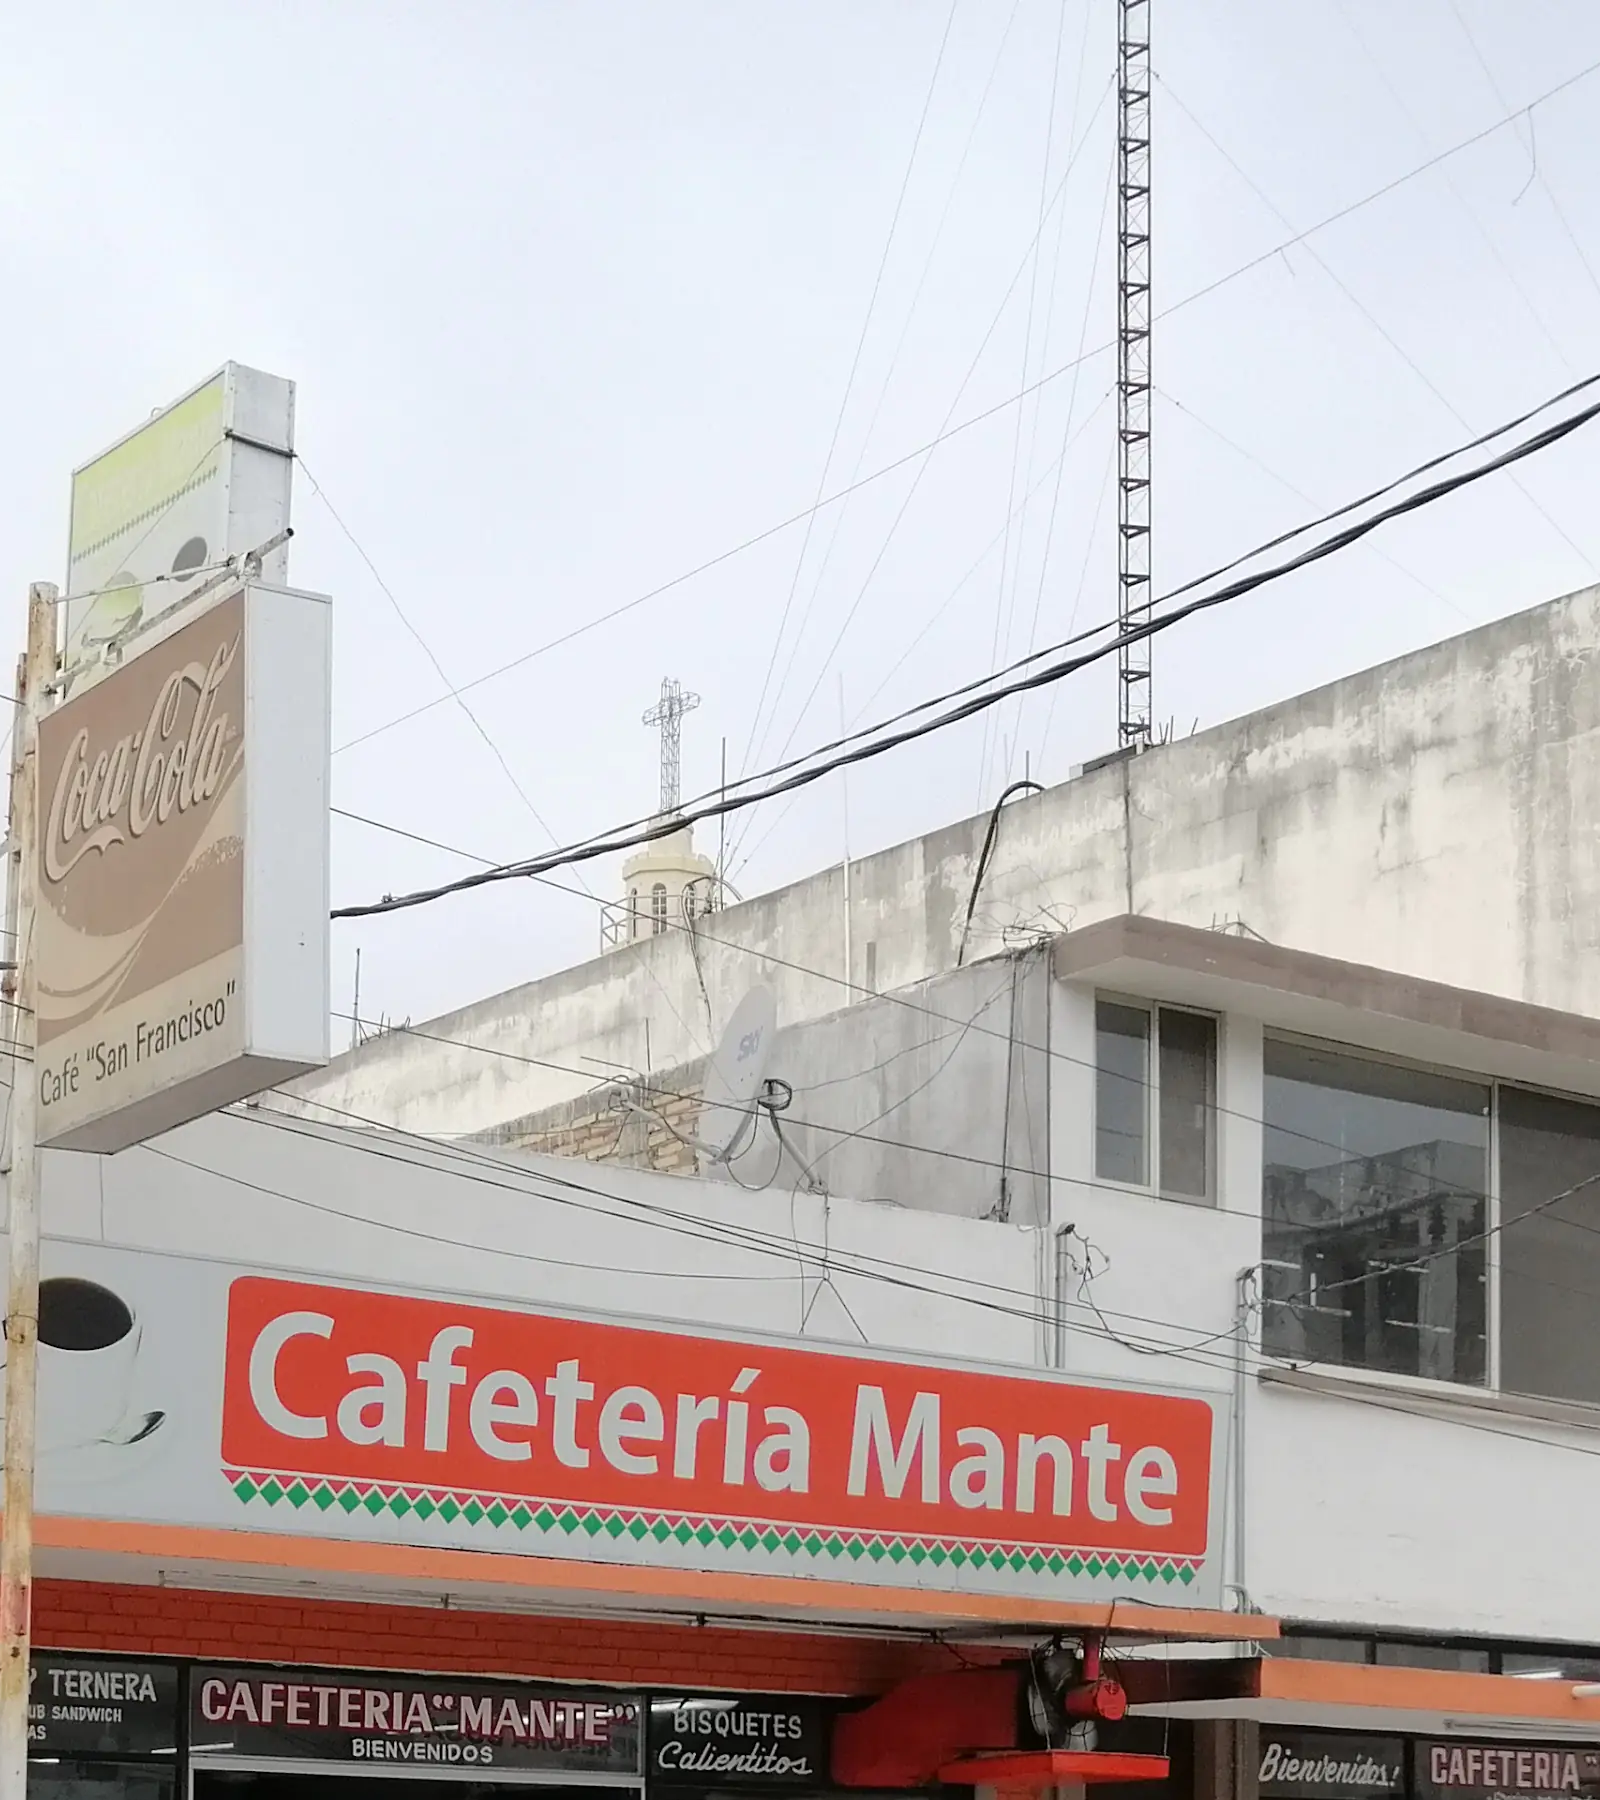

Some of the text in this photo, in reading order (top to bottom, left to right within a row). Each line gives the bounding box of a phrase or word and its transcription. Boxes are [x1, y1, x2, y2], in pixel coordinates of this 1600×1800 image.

[40, 1052, 80, 1107] Café
[247, 1310, 1180, 1528] Cafetería Mante
[48, 1668, 158, 1702] TERNERA
[51, 1705, 123, 1723] SANDWICH
[200, 1677, 432, 1734] CAFETERIA
[673, 1709, 803, 1739] BISQUETES
[351, 1737, 493, 1764] BIENVENIDOS
[657, 1740, 814, 1775] Calientitos
[1430, 1746, 1582, 1791] CAFETERIA
